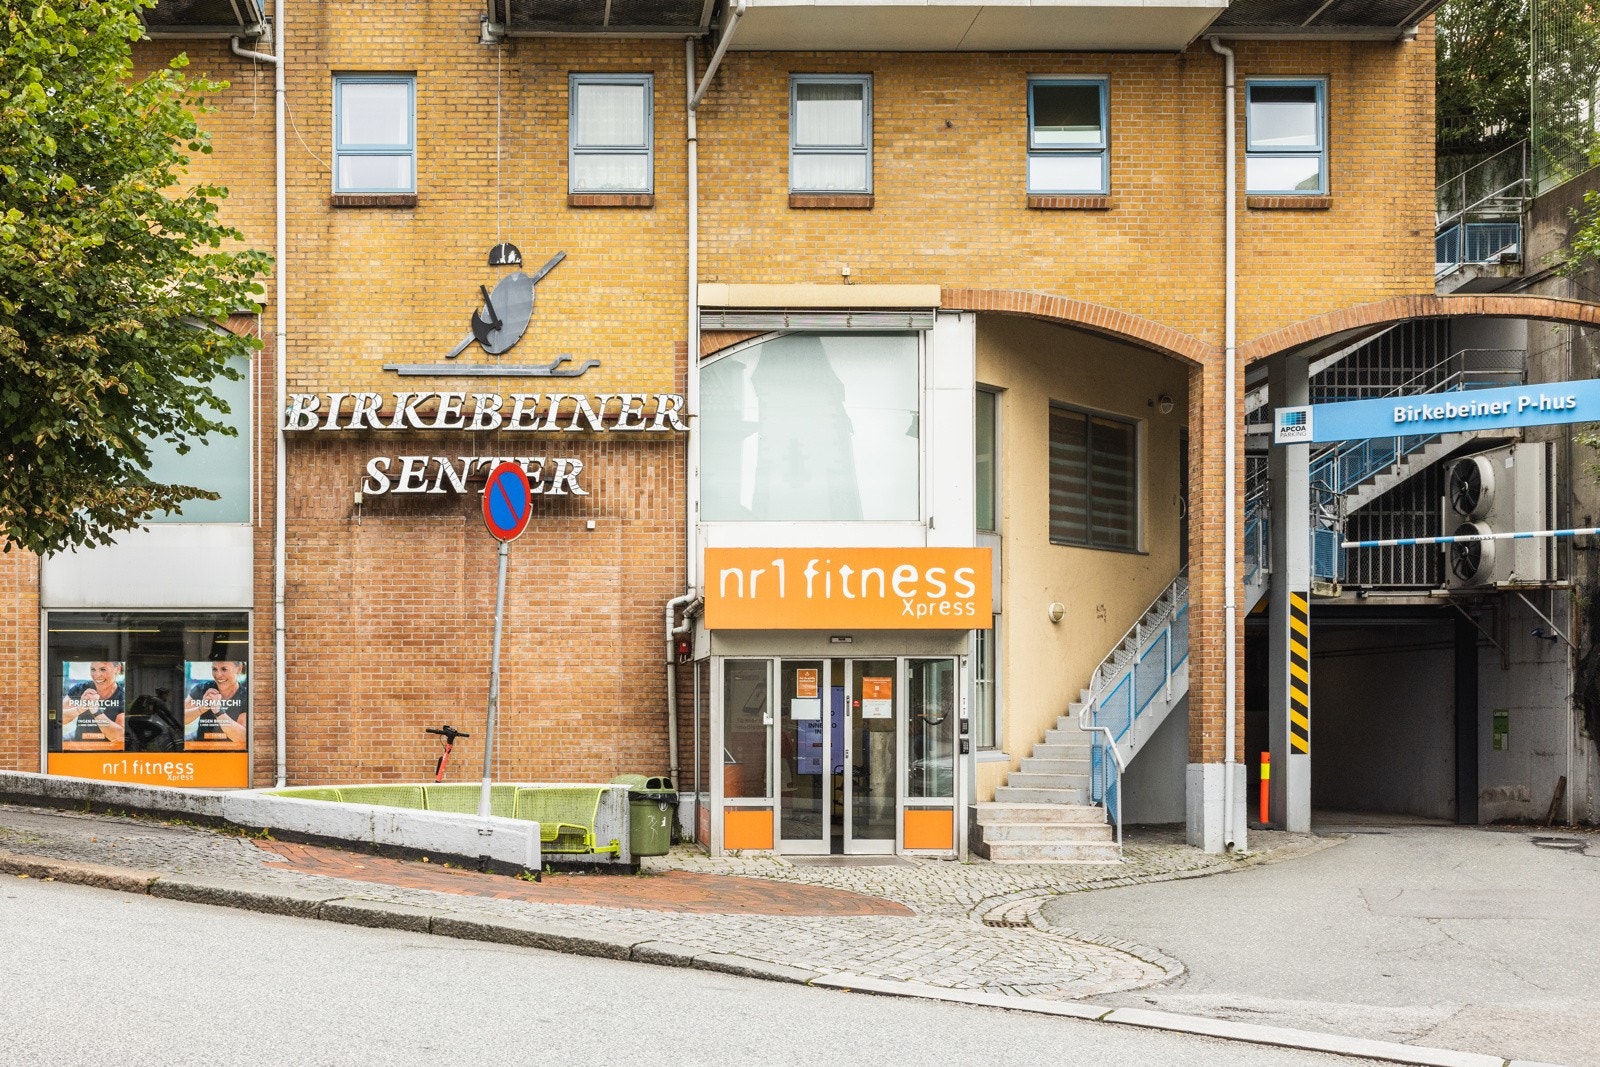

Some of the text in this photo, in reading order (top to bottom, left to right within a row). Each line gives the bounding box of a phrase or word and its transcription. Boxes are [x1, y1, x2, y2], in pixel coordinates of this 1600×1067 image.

[283, 391, 690, 432] BIRKEBEINER
[1393, 393, 1577, 424] Birkebeiner P-hus
[1281, 425, 1307, 433] APCOA
[719, 558, 976, 599] nr1 fitness
[902, 598, 976, 619] Xpress
[69, 699, 120, 707] PRISMATCH!
[190, 699, 241, 707] PRISMATCH!
[103, 759, 194, 775] nr1 fitness
[167, 773, 194, 781] Xpress
